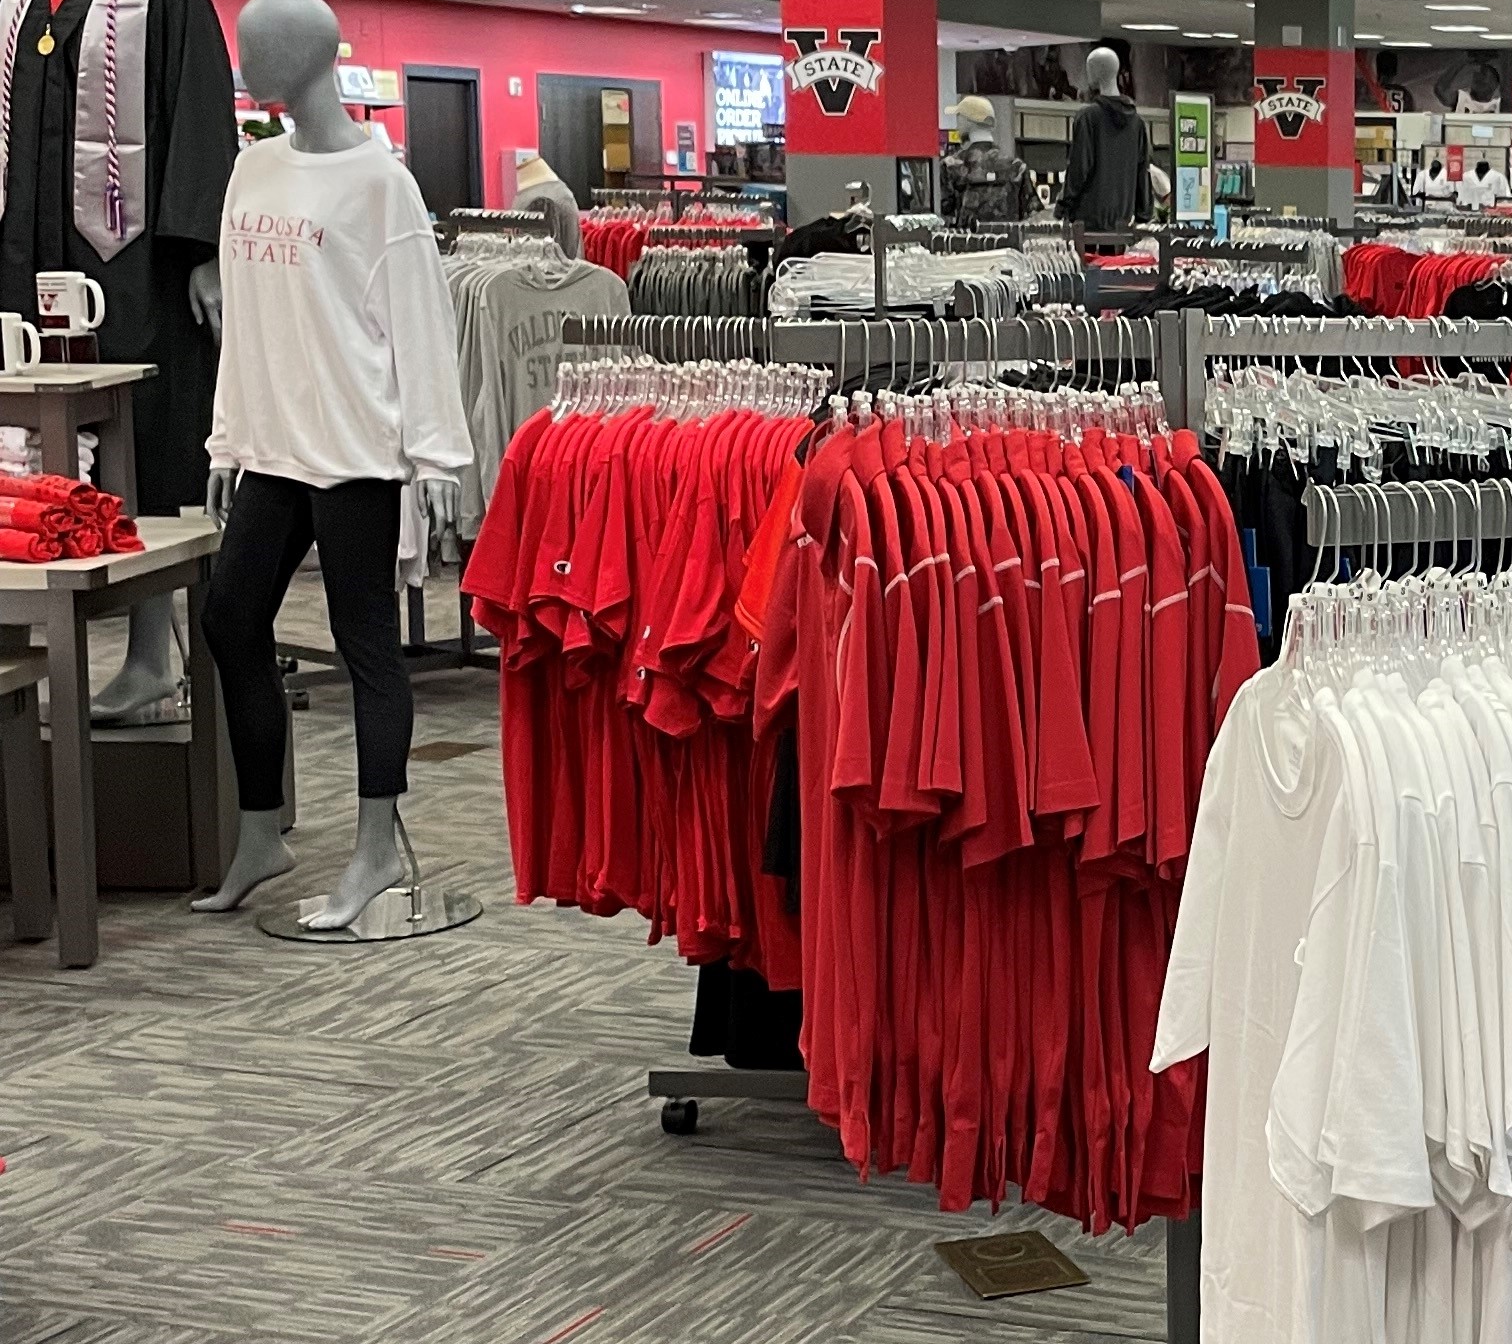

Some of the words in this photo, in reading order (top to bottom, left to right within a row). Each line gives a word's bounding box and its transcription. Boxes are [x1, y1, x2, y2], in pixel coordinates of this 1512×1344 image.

[803, 56, 865, 77] STATE
[715, 87, 767, 109] ONLINE
[1267, 96, 1313, 112] STATE
[715, 107, 762, 128] ORDER
[229, 212, 325, 247] ALDOSTA
[230, 239, 302, 266] STATE
